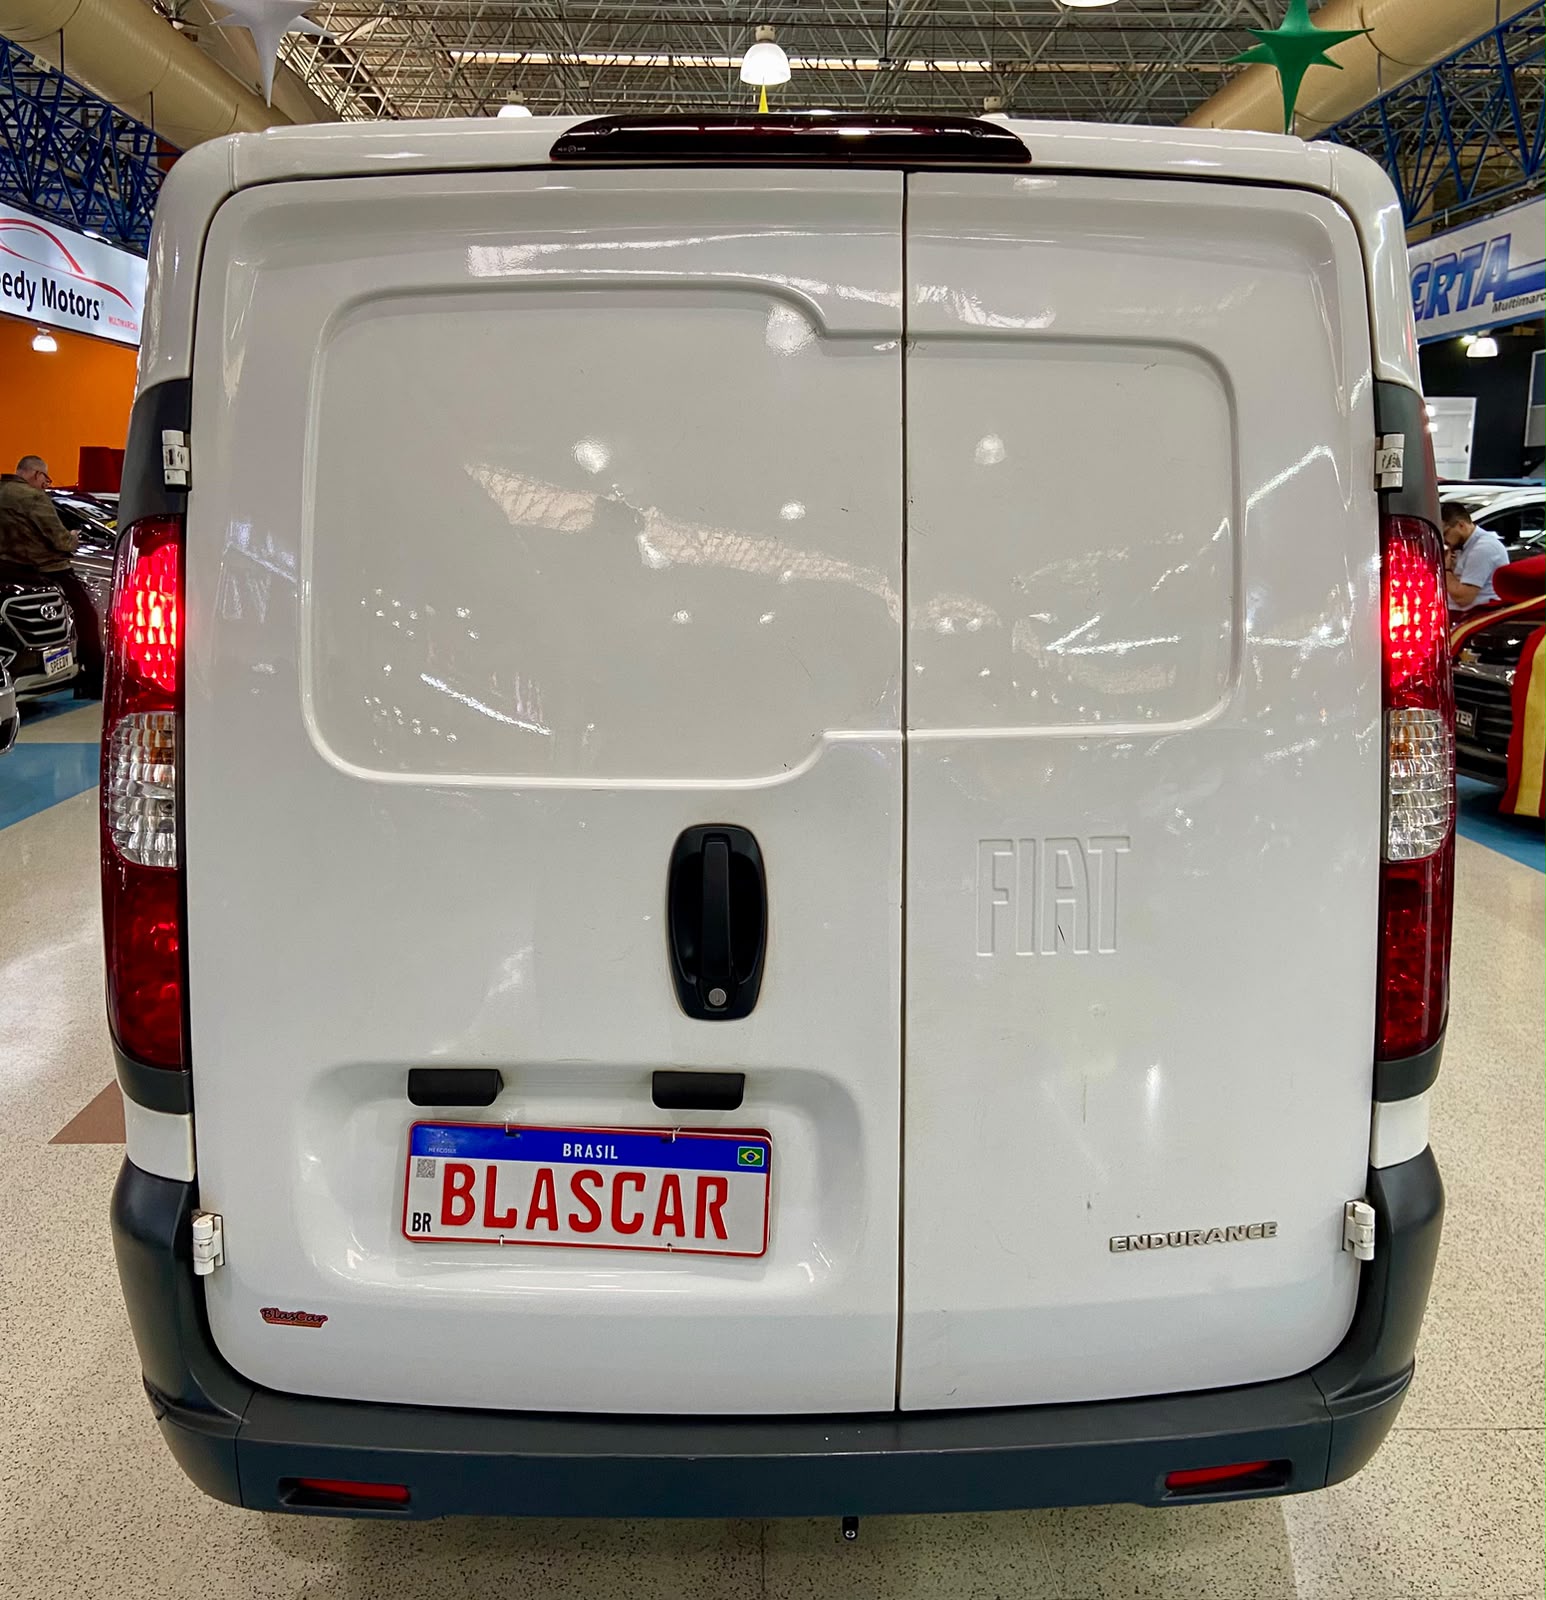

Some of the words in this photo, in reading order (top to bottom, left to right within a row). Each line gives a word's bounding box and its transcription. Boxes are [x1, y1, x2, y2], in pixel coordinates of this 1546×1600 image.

[0, 270, 36, 312] edy
[42, 277, 100, 321] Motors
[50, 655, 69, 673] SPEEDY
[976, 835, 1131, 956] FIAT
[562, 1142, 619, 1160] BRASIL
[440, 1162, 729, 1240] BLASCAR
[411, 1212, 432, 1233] BR
[1109, 1221, 1278, 1252] ENDURANCE
